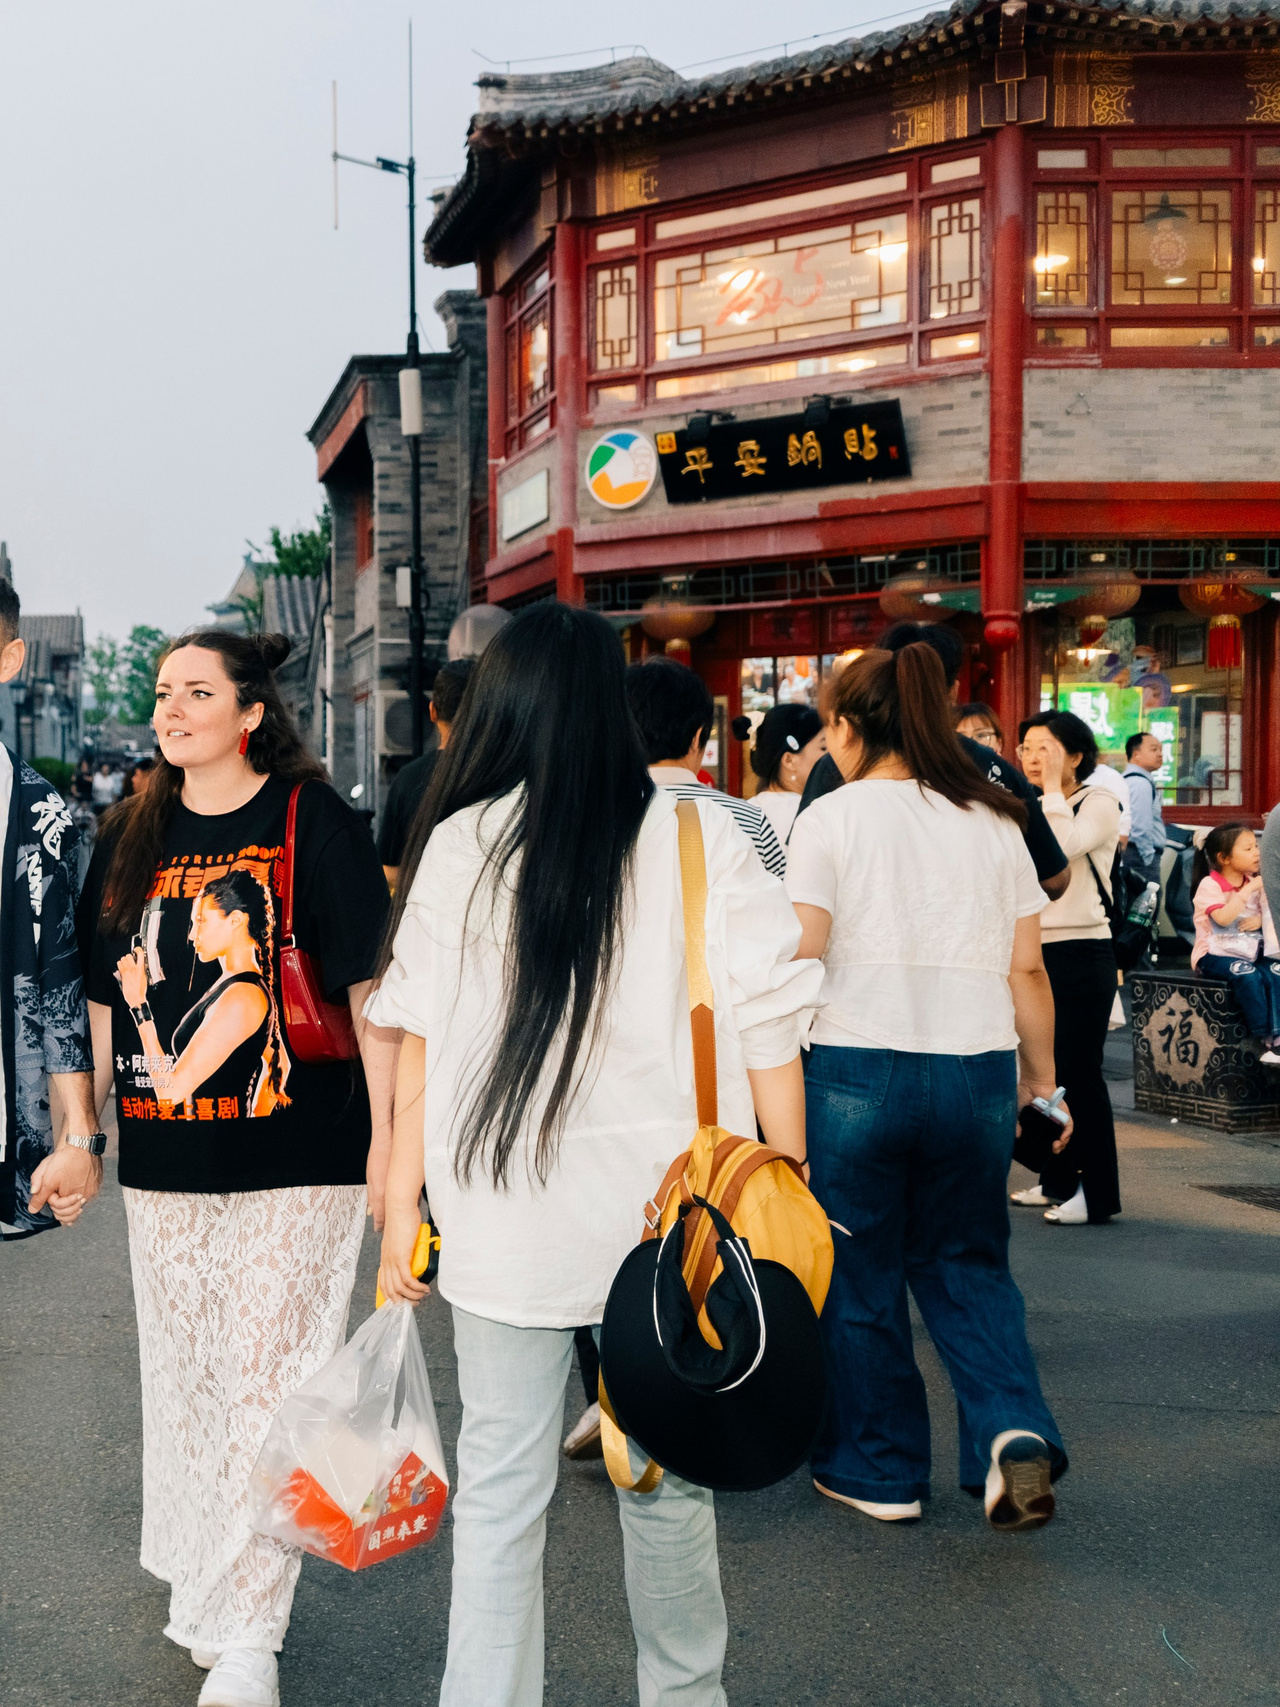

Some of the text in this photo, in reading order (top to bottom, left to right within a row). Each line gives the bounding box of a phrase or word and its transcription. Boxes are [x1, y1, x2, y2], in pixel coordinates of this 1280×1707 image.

[825, 277, 849, 291] New
[850, 273, 872, 287] Year
[1158, 1006, 1200, 1068] 福
[121, 1095, 239, 1121] 当动作爱上喜剧
